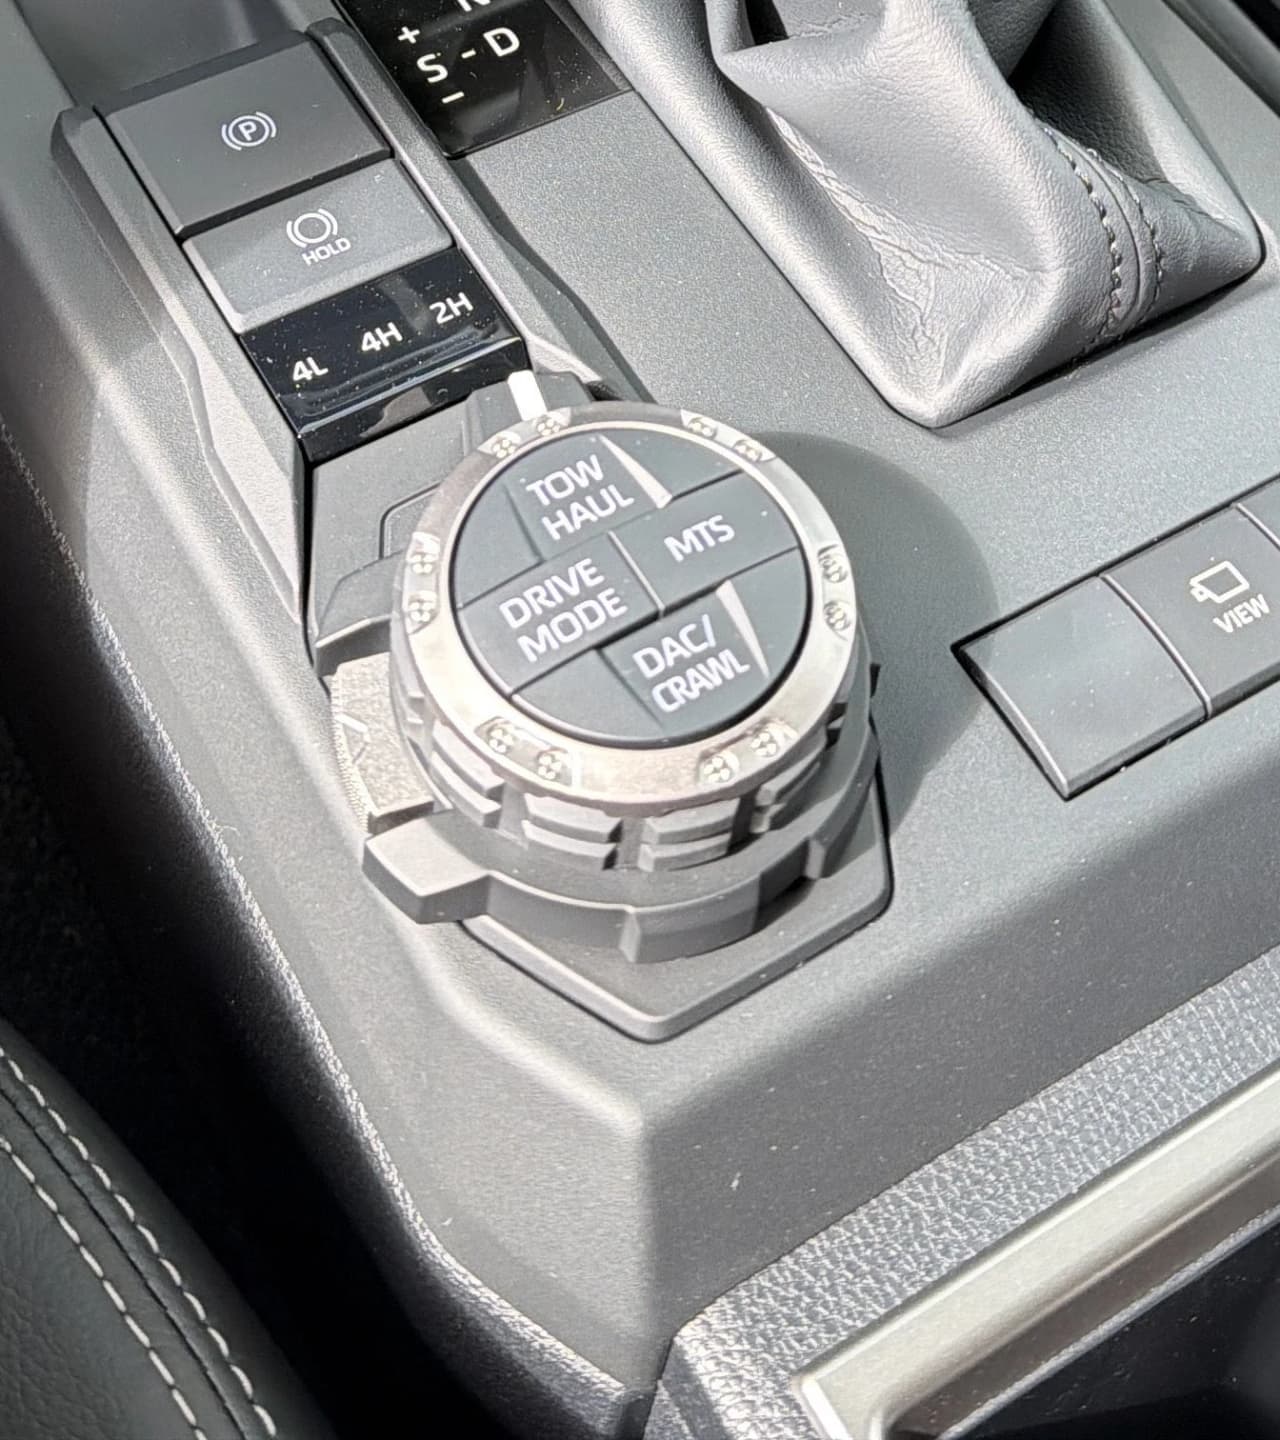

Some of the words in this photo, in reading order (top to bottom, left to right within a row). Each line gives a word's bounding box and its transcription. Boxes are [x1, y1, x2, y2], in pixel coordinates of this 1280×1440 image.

[416, 52, 448, 84] S
[483, 26, 520, 57] D
[238, 121, 258, 141] P
[301, 237, 352, 266] HOLD
[290, 356, 329, 383] 4L
[360, 322, 404, 354] 4H
[429, 291, 474, 326] 2H
[526, 453, 604, 507] TOW
[541, 483, 635, 541] HAUL
[663, 514, 736, 563] MTS
[498, 557, 606, 630] DRIVE
[1213, 594, 1270, 633] VIEW
[516, 587, 628, 663] MODE
[632, 614, 718, 680] DAC/
[651, 648, 751, 713] CRAWL
